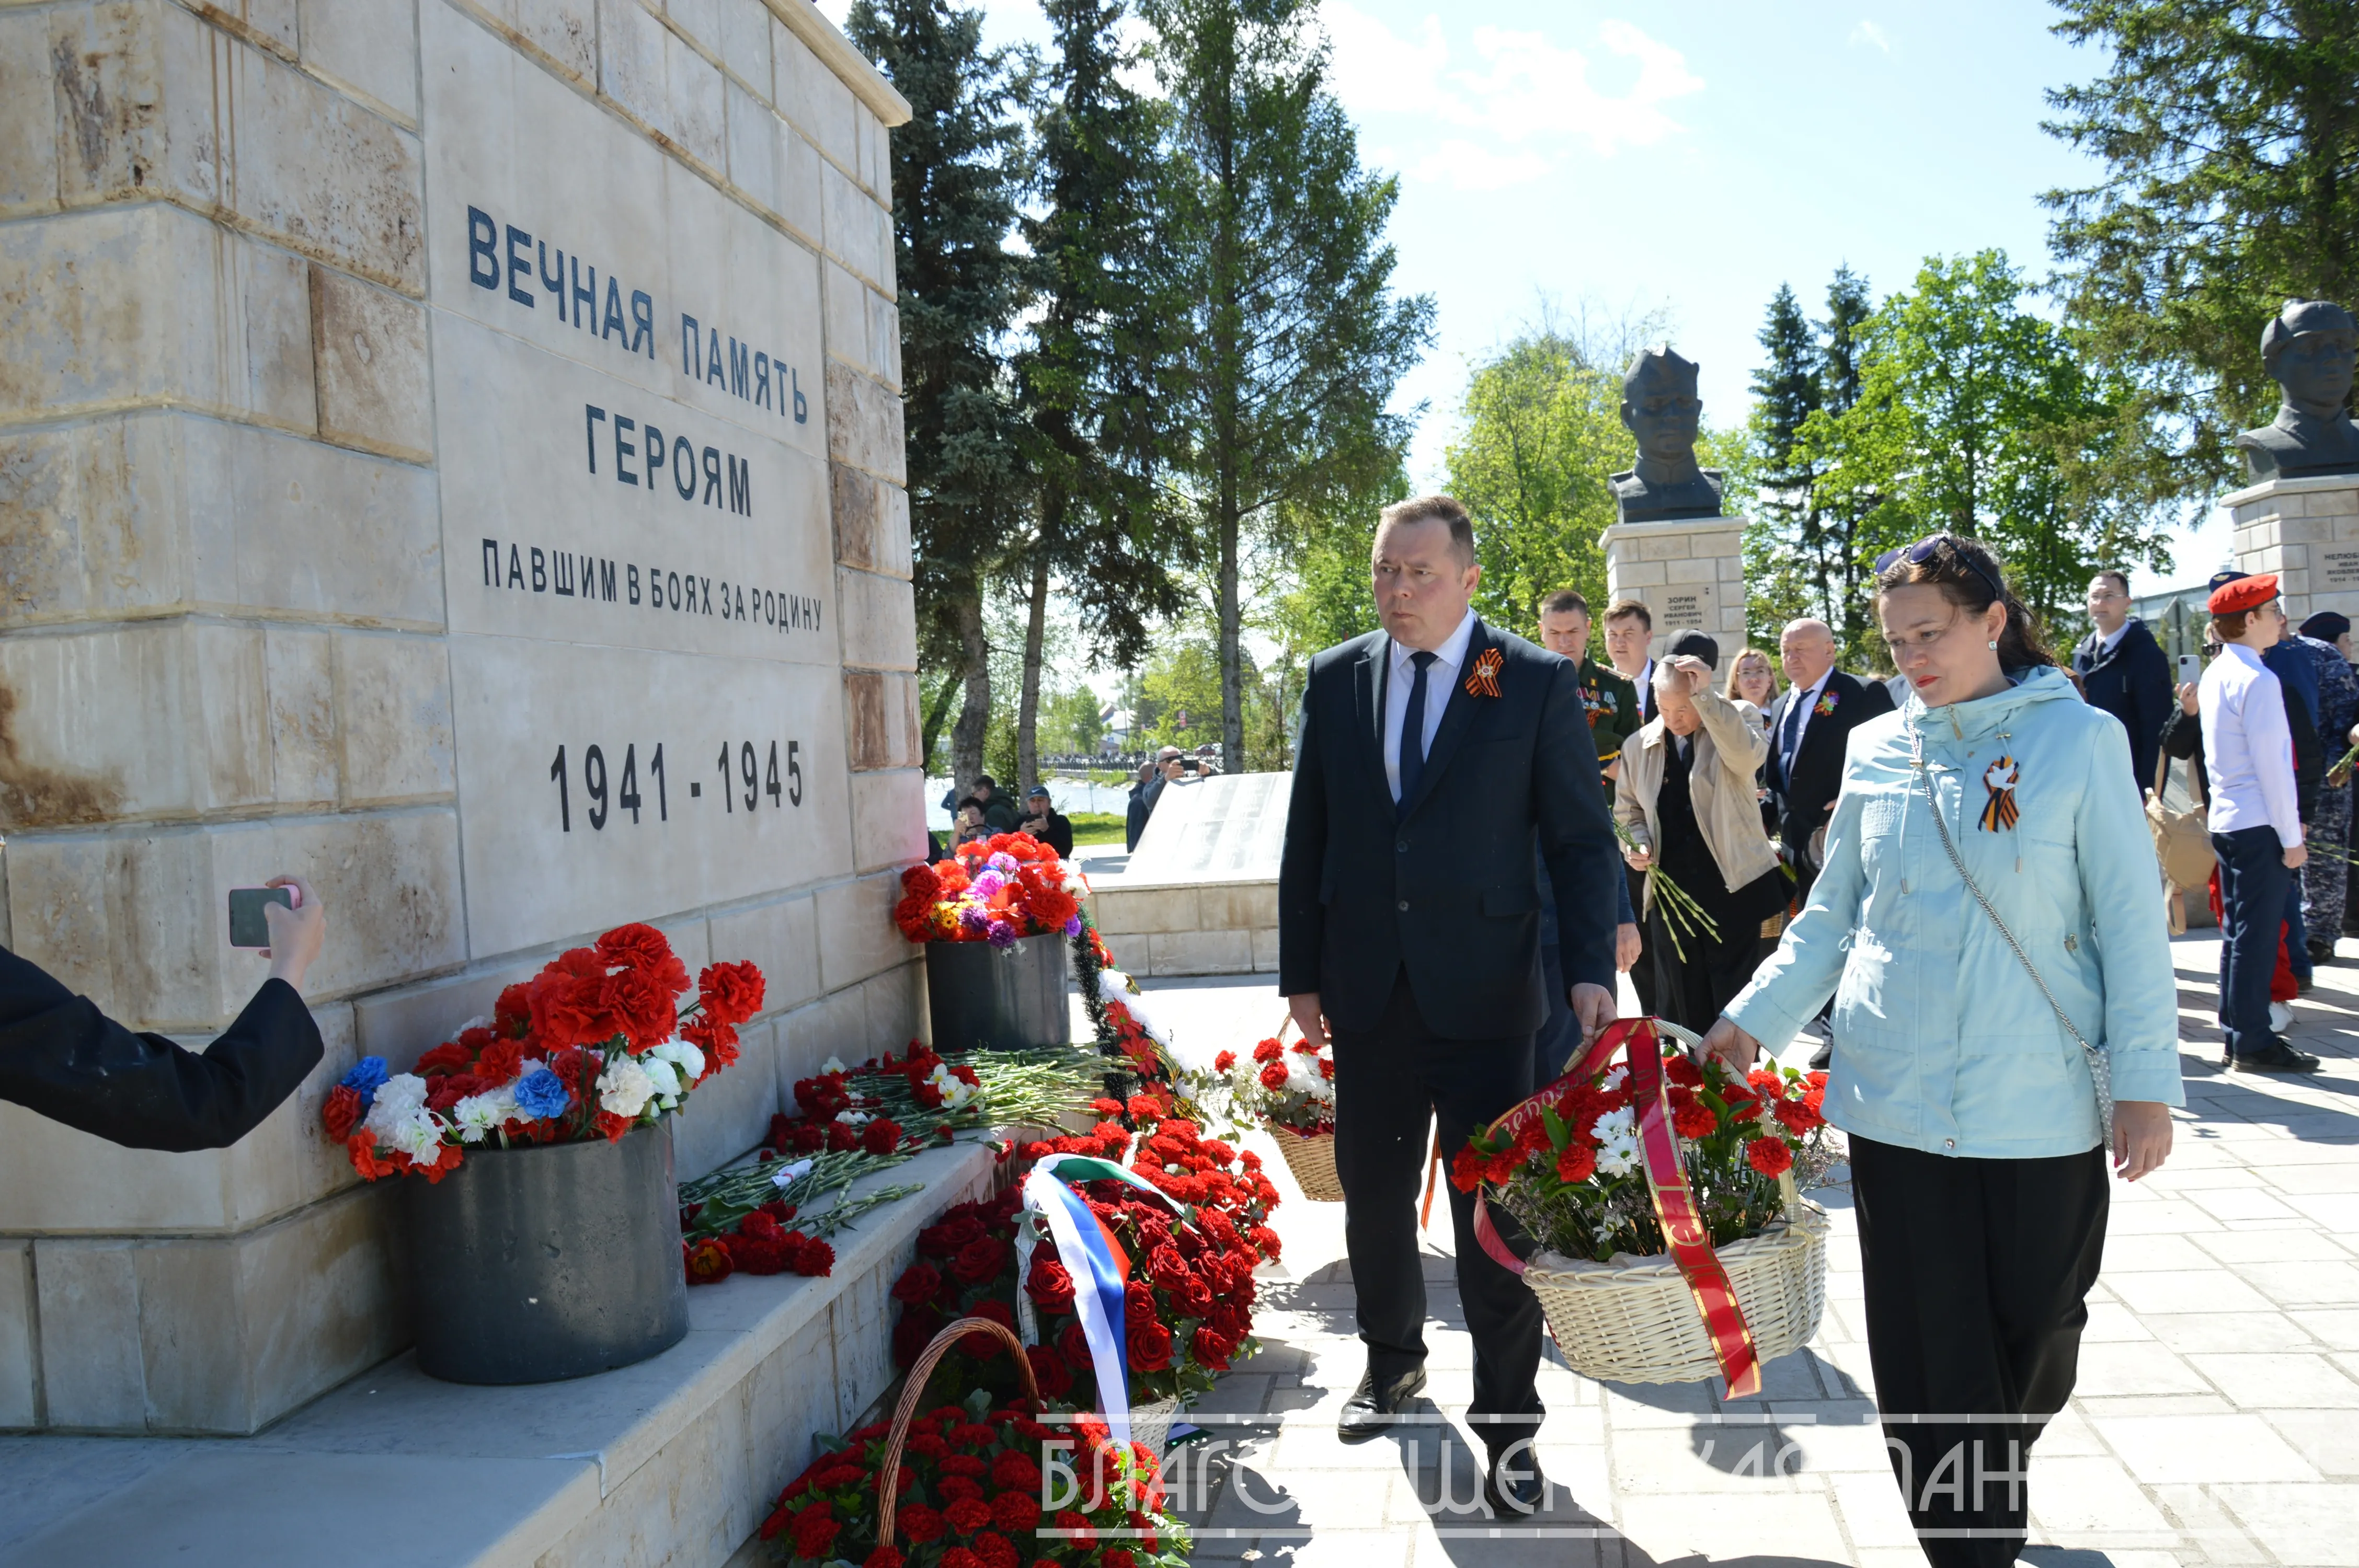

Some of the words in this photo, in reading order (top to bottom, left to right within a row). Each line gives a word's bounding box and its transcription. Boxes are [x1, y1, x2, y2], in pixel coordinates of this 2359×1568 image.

[468, 205, 654, 360] ВЕЧНАЯ
[682, 313, 807, 424] ПАМЯТЬ
[586, 404, 751, 517] ГЕРОЯМ
[483, 538, 617, 602] ПАВШИМ
[627, 564, 641, 605] В
[651, 568, 713, 615] БОЯХ
[721, 582, 746, 621] ЗА
[753, 588, 822, 633] РОДИНУ
[551, 743, 668, 832] 1941
[718, 741, 802, 813] 1945
